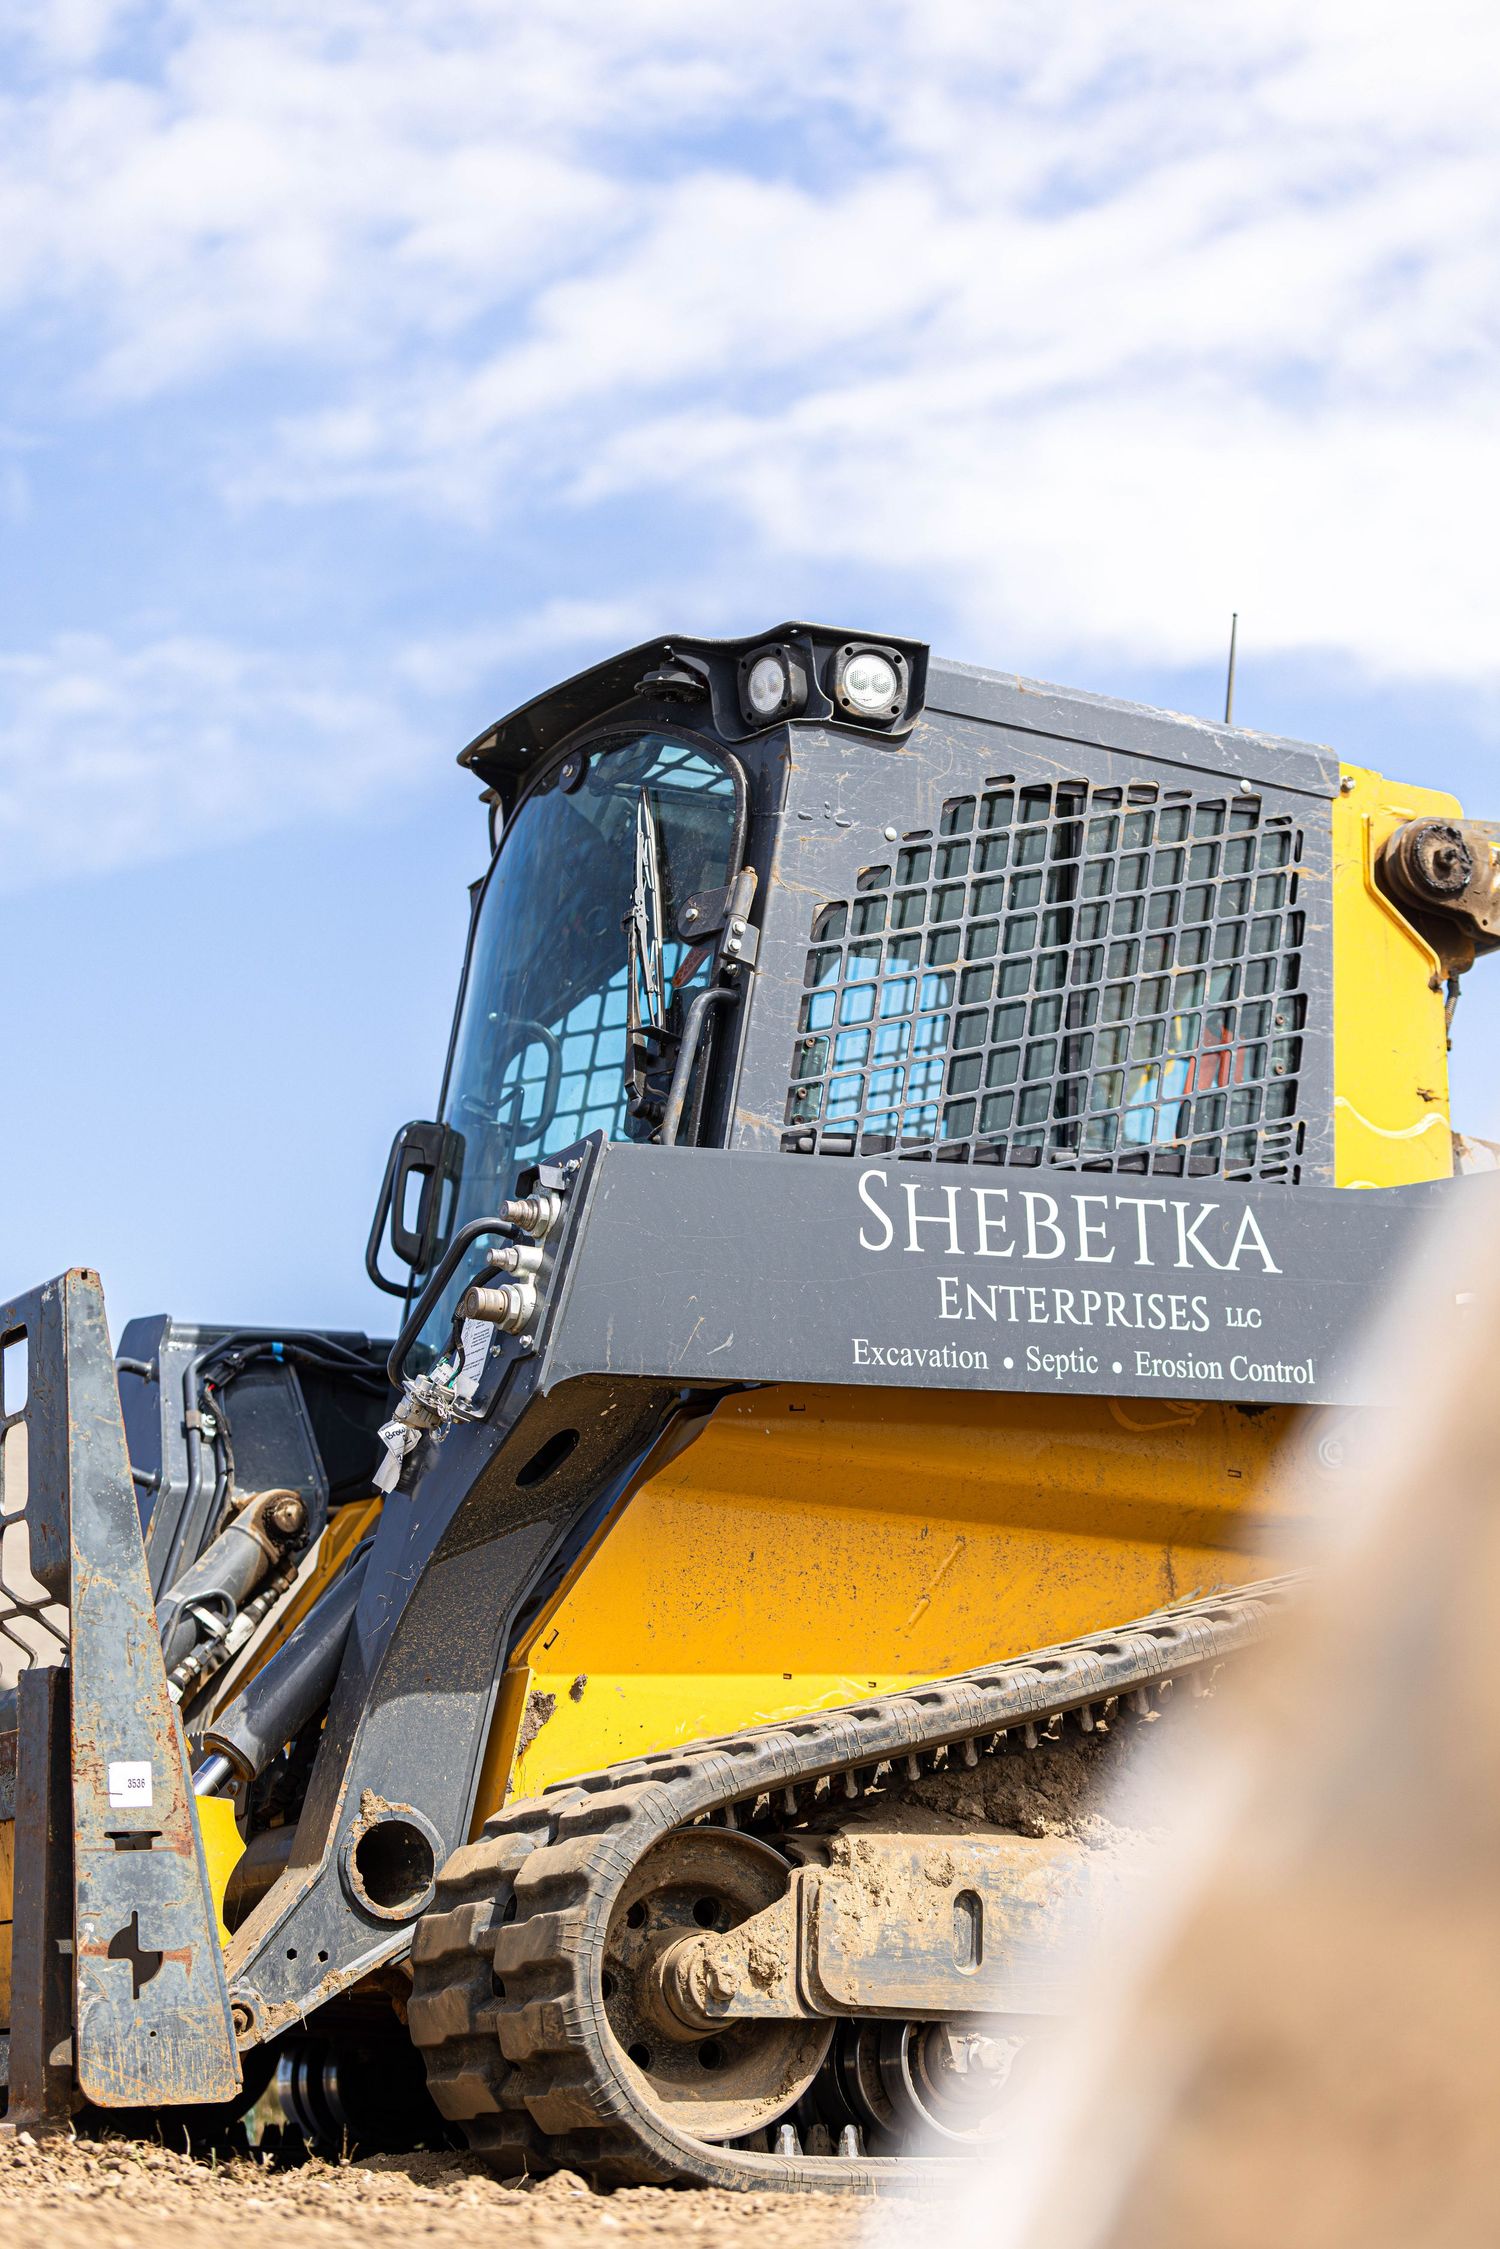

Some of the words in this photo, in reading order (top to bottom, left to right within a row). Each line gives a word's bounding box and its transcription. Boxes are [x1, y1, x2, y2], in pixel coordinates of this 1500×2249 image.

[858, 1169, 1283, 1274] SHEBETKA
[937, 1276, 1210, 1332] ENTERPRISES
[1225, 1306, 1262, 1329] LLC
[851, 1338, 989, 1370] Excavation
[1026, 1345, 1099, 1380] Septic
[1134, 1350, 1224, 1380] Erosion
[1229, 1355, 1316, 1385] Control
